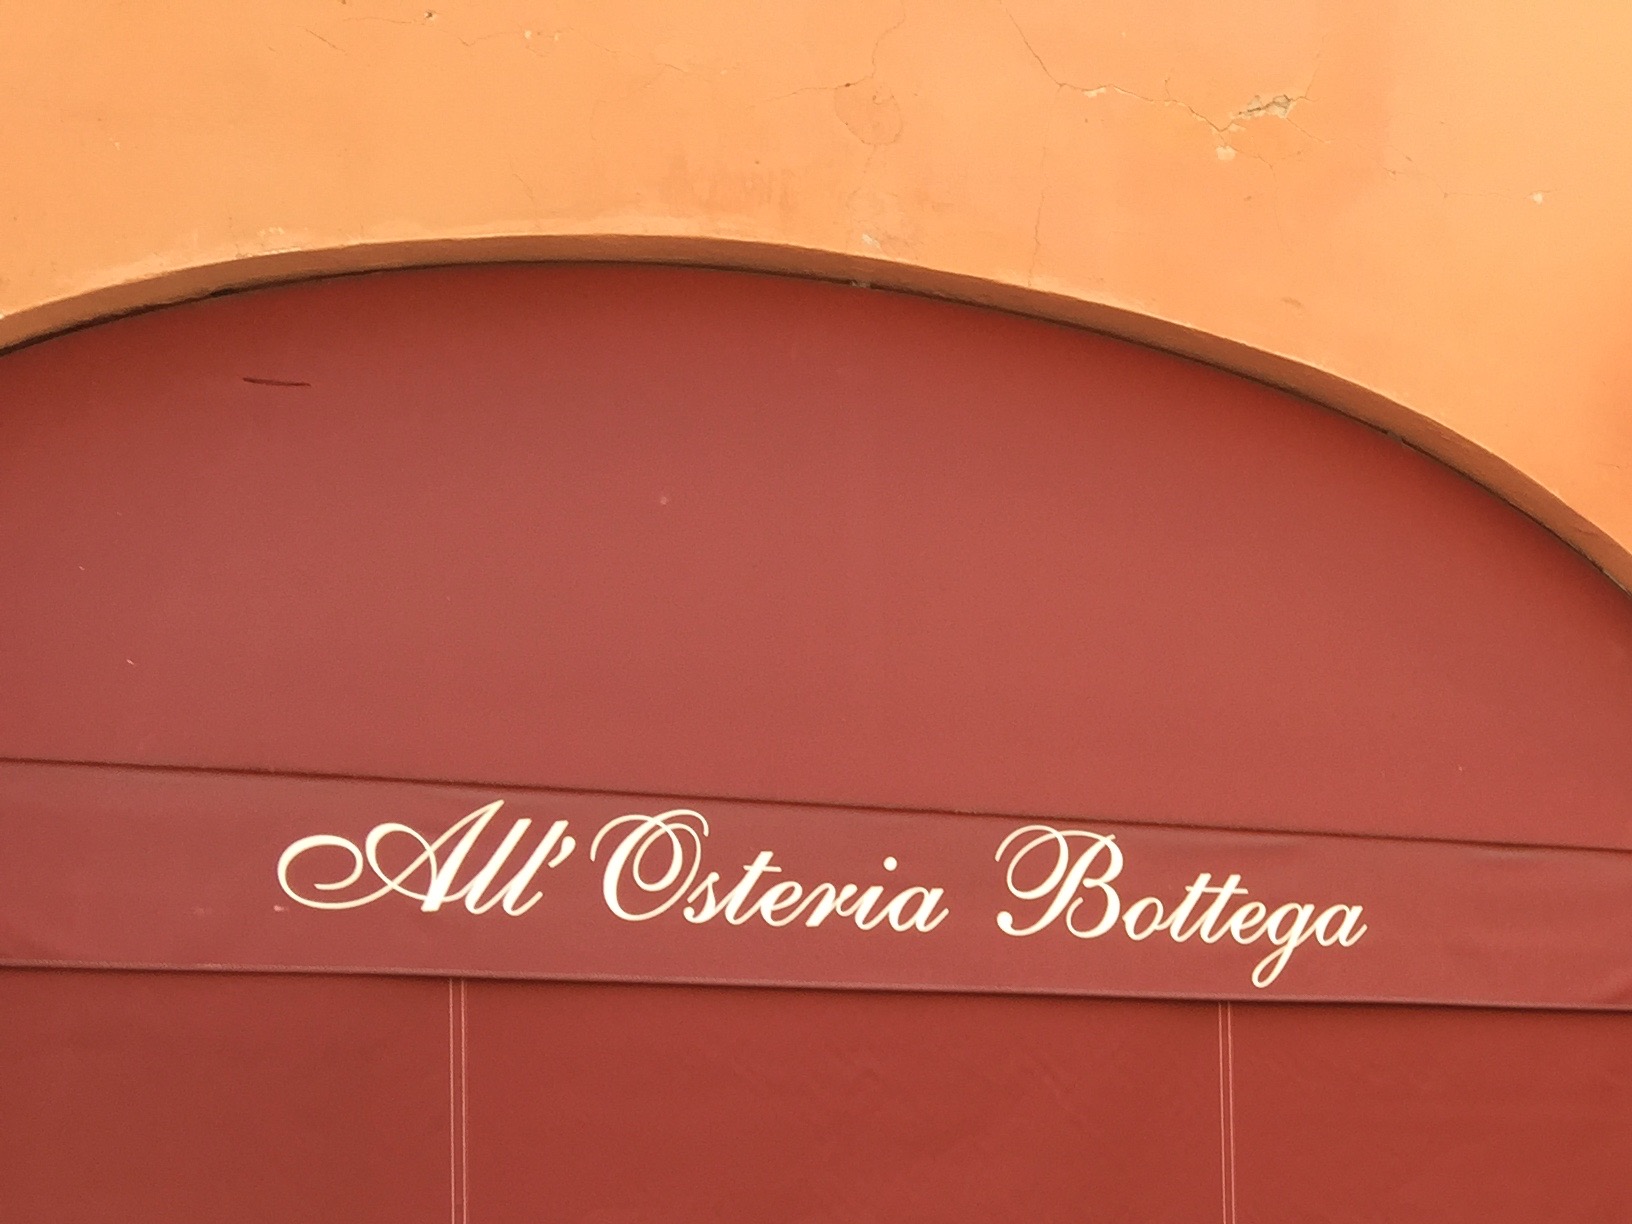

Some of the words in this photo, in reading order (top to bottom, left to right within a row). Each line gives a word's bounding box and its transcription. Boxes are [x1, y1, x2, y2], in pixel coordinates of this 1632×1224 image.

[276, 799, 576, 917] All'
[590, 808, 949, 932] Osteria
[995, 825, 1367, 988] Bottega
